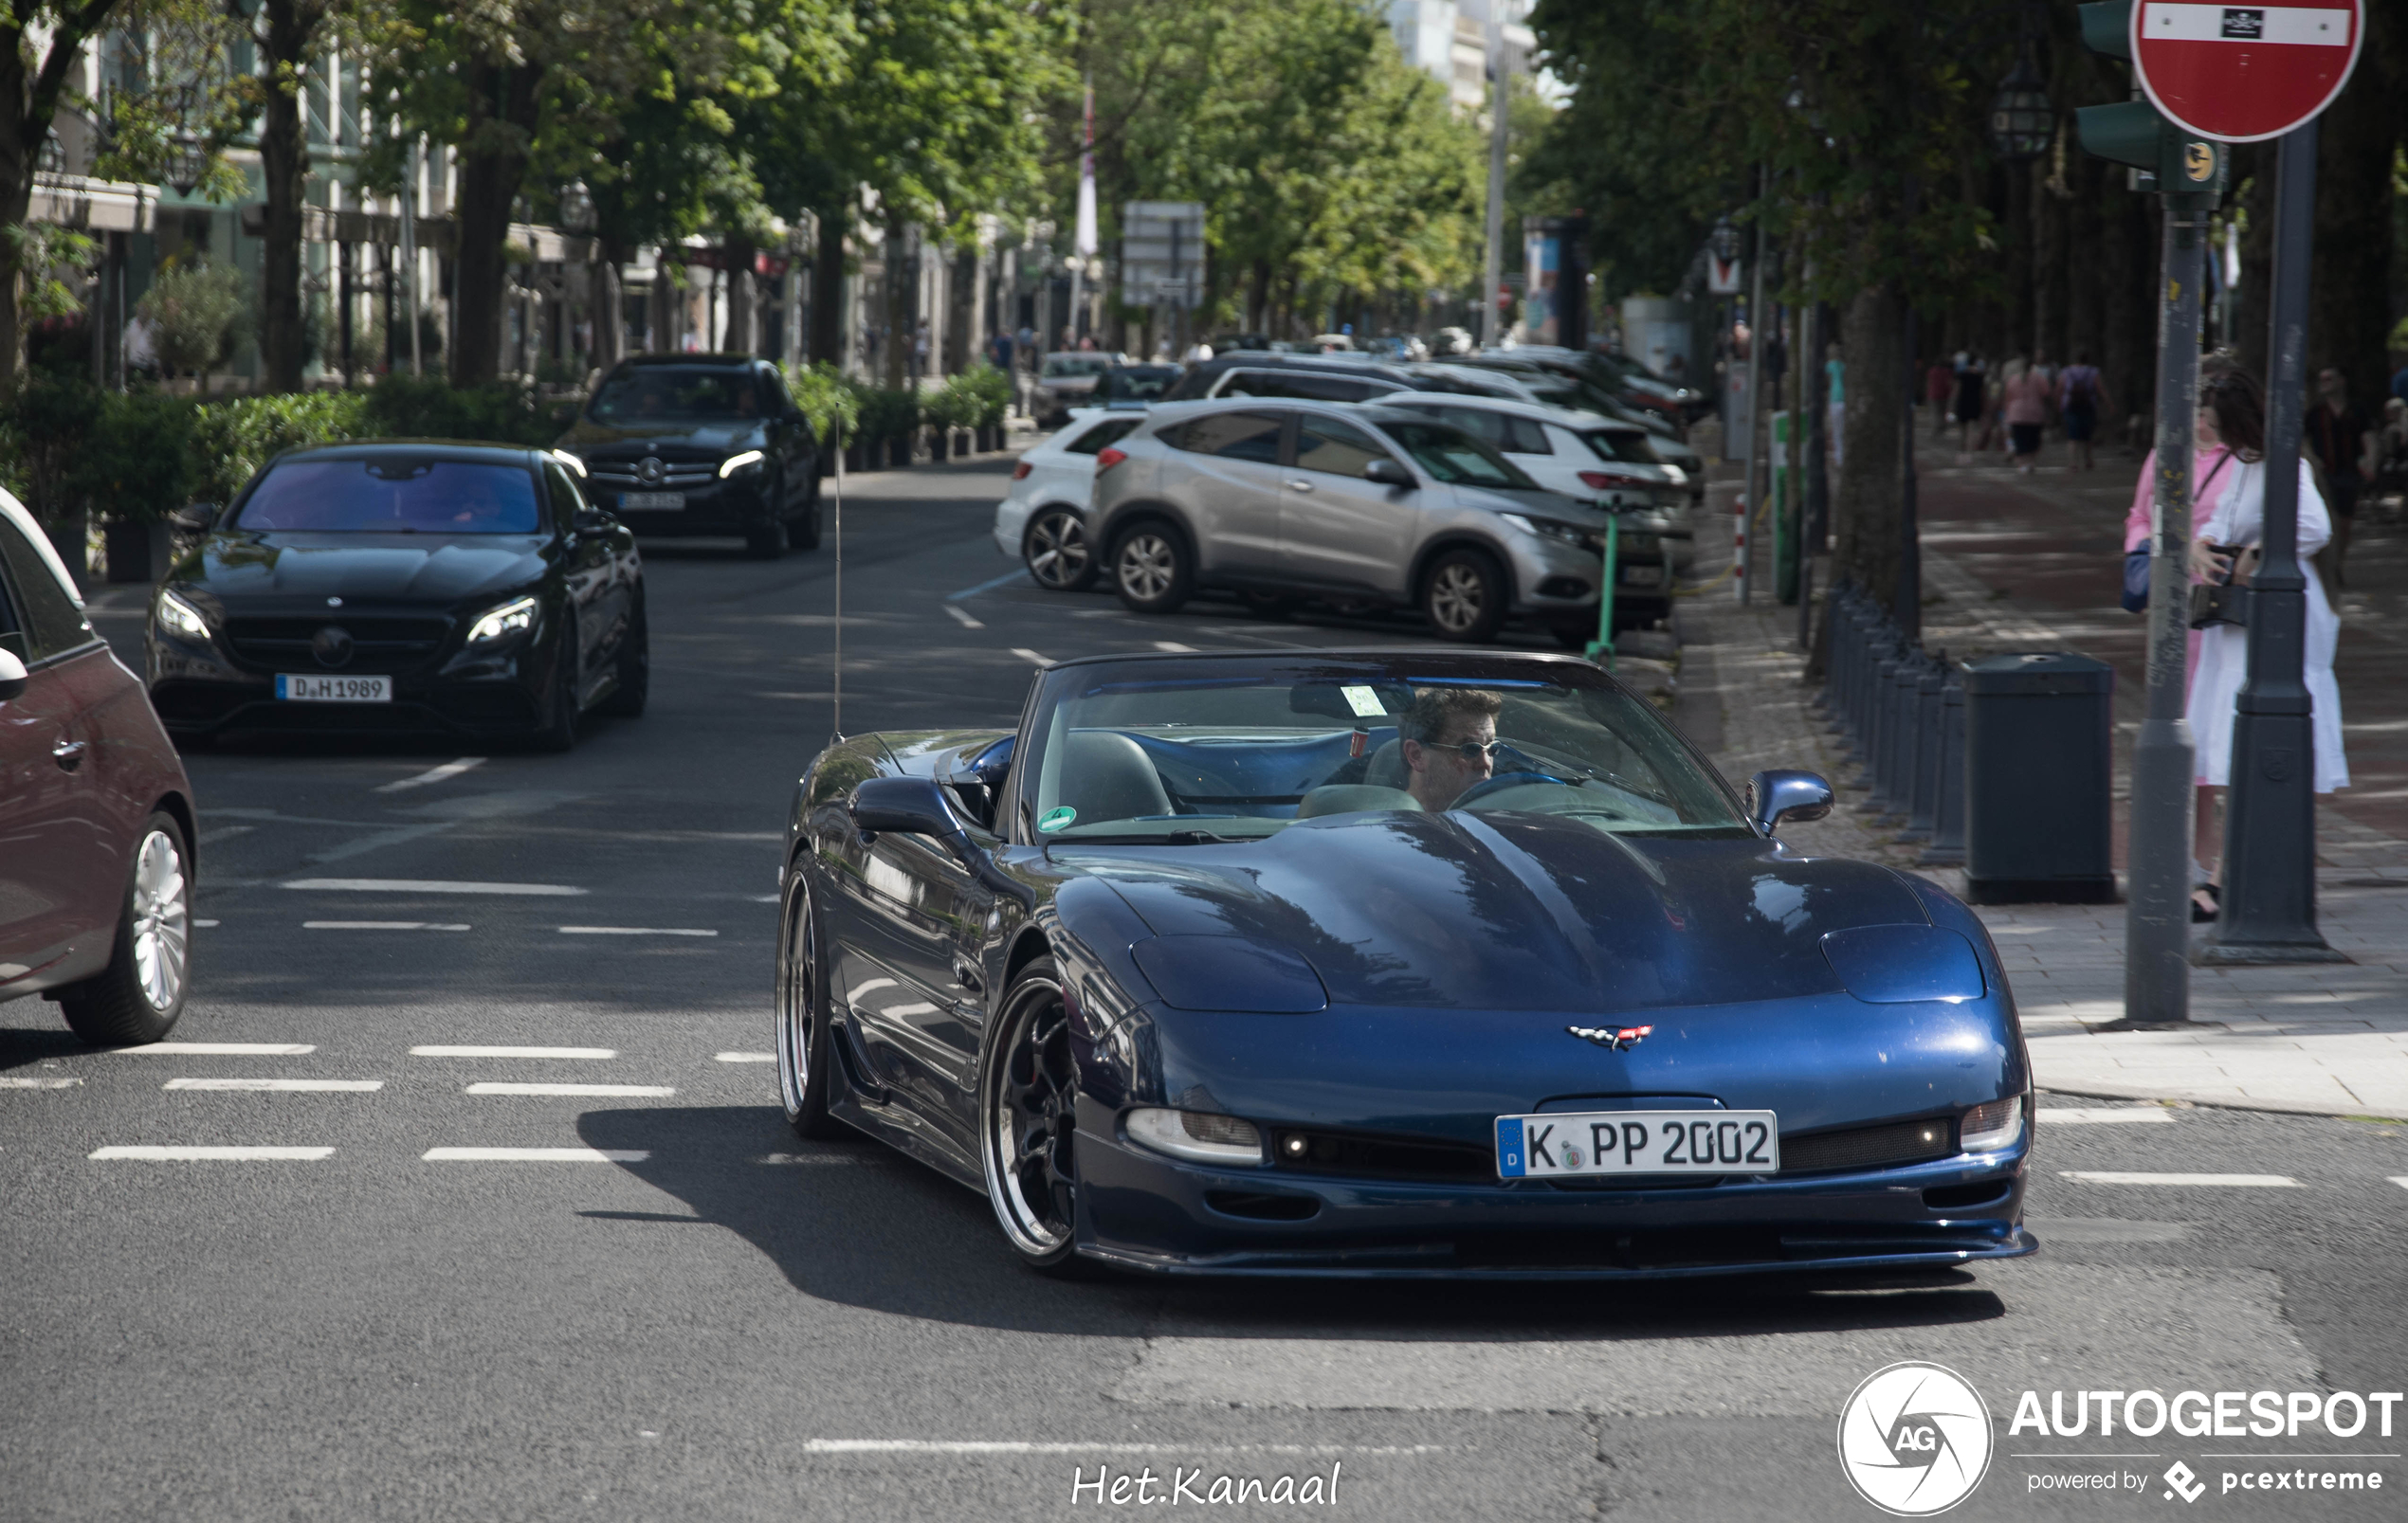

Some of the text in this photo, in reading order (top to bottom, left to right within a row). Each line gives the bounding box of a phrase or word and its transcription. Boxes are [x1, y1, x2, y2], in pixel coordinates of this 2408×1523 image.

[295, 678, 307, 697] D
[1051, 807, 1063, 819] 4
[1527, 1120, 1770, 1168] K PP 2002
[1506, 1152, 1518, 1167] D
